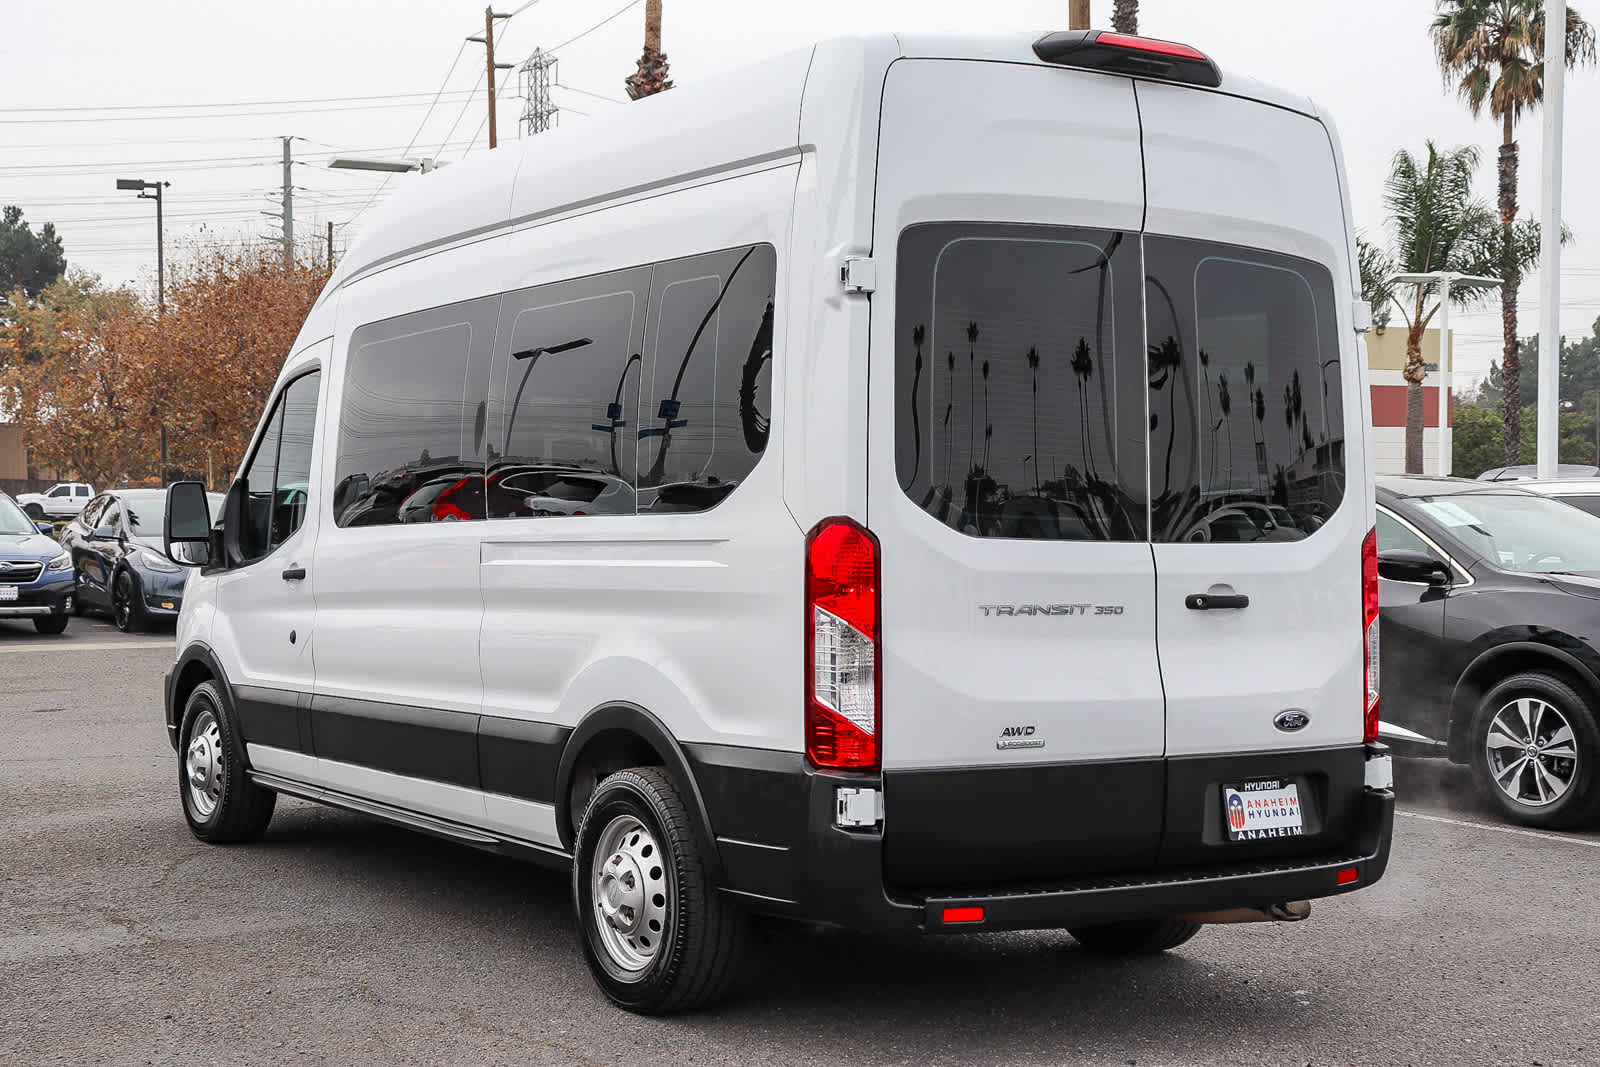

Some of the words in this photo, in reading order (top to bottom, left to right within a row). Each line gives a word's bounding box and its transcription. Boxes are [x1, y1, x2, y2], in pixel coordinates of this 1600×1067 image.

[978, 603, 1092, 616] TRANSIT
[1094, 605, 1125, 615] 350
[999, 726, 1036, 737] AWD
[1244, 780, 1280, 791] HYUNDAI
[1247, 797, 1298, 809] ANAHEIM
[1248, 807, 1299, 819] HYUNDAI
[1237, 826, 1303, 840] ANAHEIM
